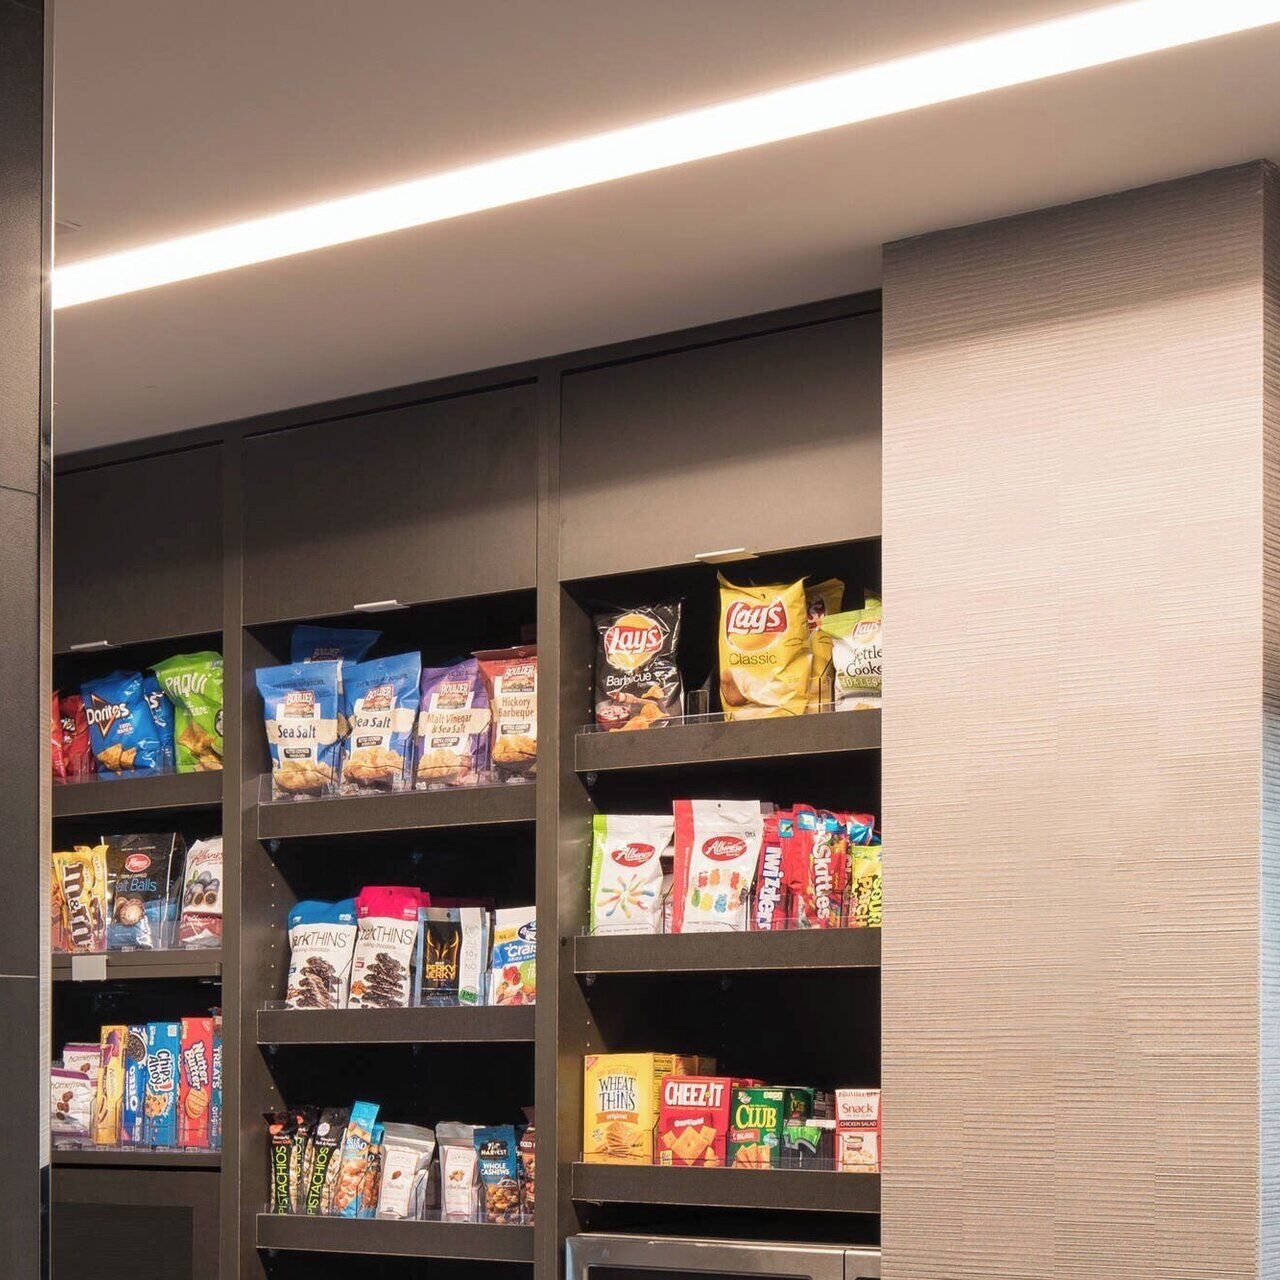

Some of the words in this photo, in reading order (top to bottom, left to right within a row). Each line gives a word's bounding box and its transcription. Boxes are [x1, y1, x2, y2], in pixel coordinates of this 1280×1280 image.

[728, 601, 787, 635] Lay's
[609, 626, 660, 655] Lay's
[729, 653, 777, 666] Classic
[504, 665, 535, 680] BOULDER
[165, 673, 208, 697] PAQUI
[366, 684, 393, 700] BOULDER
[441, 683, 469, 696] BOULDER
[286, 691, 315, 706] BOULDER
[501, 697, 531, 711] Hickory
[86, 702, 130, 725] Doritos
[446, 713, 472, 726] Vinegar
[498, 708, 535, 720] Barbeque
[371, 716, 391, 729] Salt
[439, 725, 451, 734] Sea
[452, 723, 466, 734] Salt
[278, 725, 294, 738] Sea
[297, 725, 316, 738] Salt
[130, 879, 157, 891] Balls
[426, 971, 455, 980] JERKY
[157, 1050, 172, 1084] Chips
[185, 1049, 201, 1090] Butter
[192, 1041, 208, 1085] Nutter
[213, 1045, 221, 1089] TREATS
[130, 1066, 138, 1111] OREO
[599, 1076, 635, 1092] WHEAT
[841, 1103, 874, 1114] Snack
[735, 1104, 777, 1129] CLUB
[275, 1145, 288, 1214] PISTACHIOS
[481, 1168, 510, 1176] CASHEWS
[307, 1147, 330, 1215] PISTACHIOS
